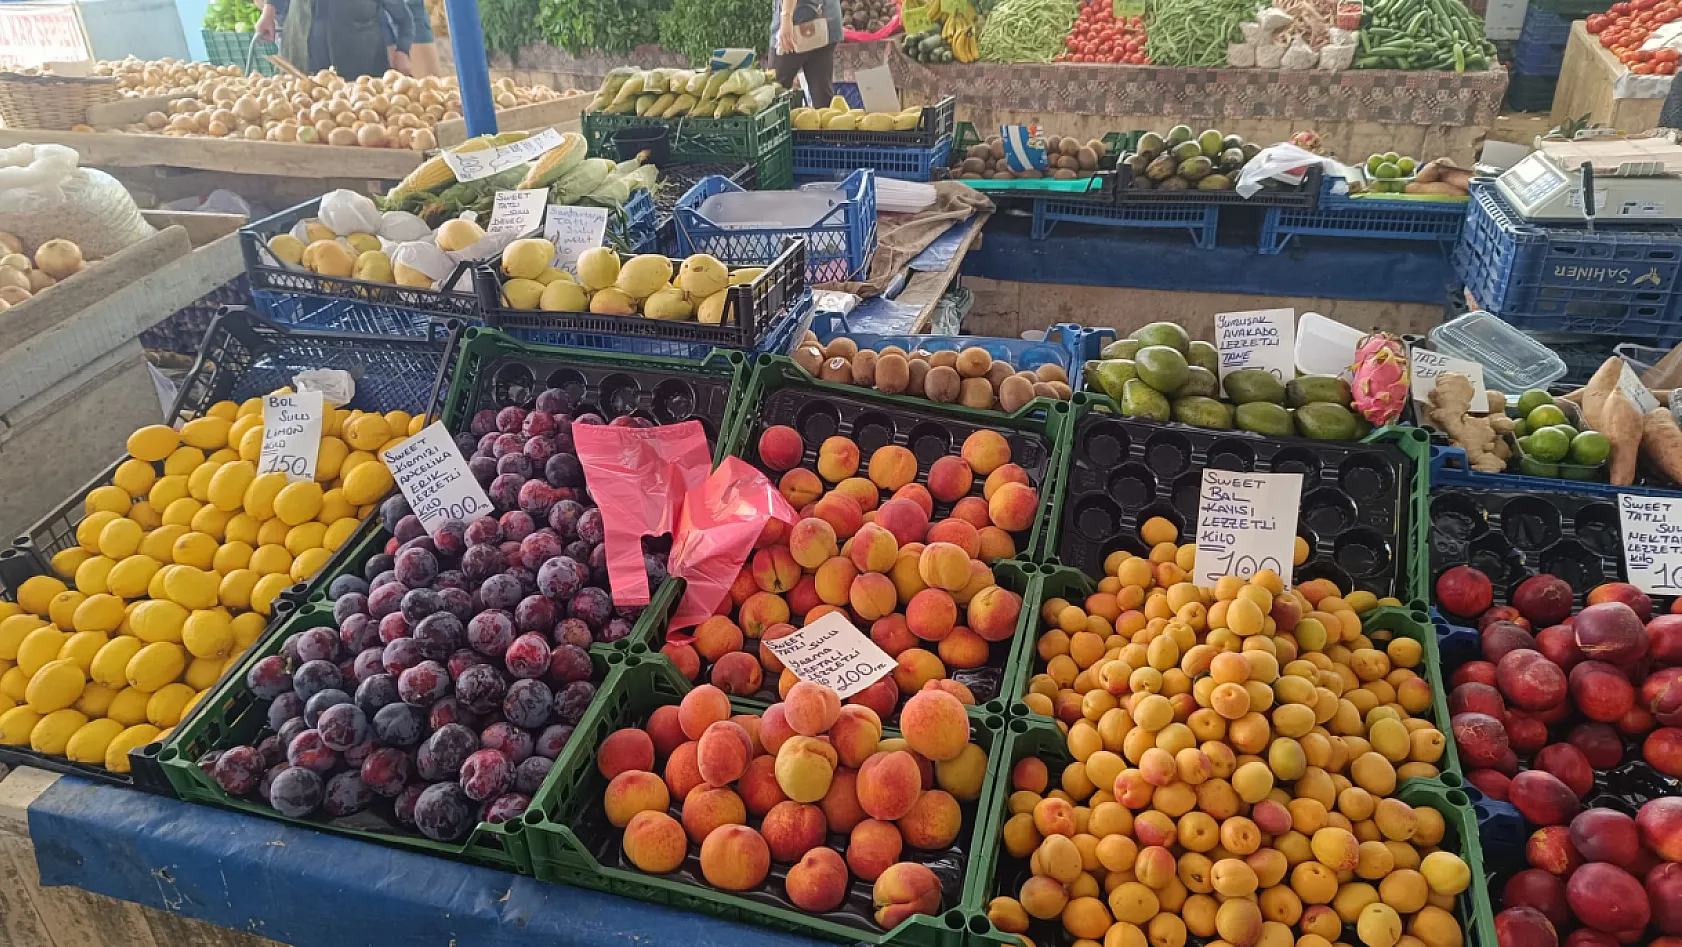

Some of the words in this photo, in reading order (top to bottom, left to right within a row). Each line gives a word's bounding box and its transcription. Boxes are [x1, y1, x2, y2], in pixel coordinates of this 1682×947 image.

[496, 192, 531, 200] SWEET
[1414, 351, 1449, 367] TAZE
[269, 396, 298, 408] BOL
[384, 437, 427, 463] SWEET
[262, 455, 308, 475] 150
[1203, 471, 1266, 489] SWEET
[1201, 486, 1251, 503] BAL
[1622, 496, 1672, 512] SWEET
[1624, 510, 1667, 523] TATLI
[1655, 522, 1682, 534] SUL
[1206, 550, 1283, 581] 100
[1651, 562, 1682, 589] 10
[766, 631, 805, 651] SWEET
[807, 630, 840, 651] SULU
[836, 662, 874, 691] 100
